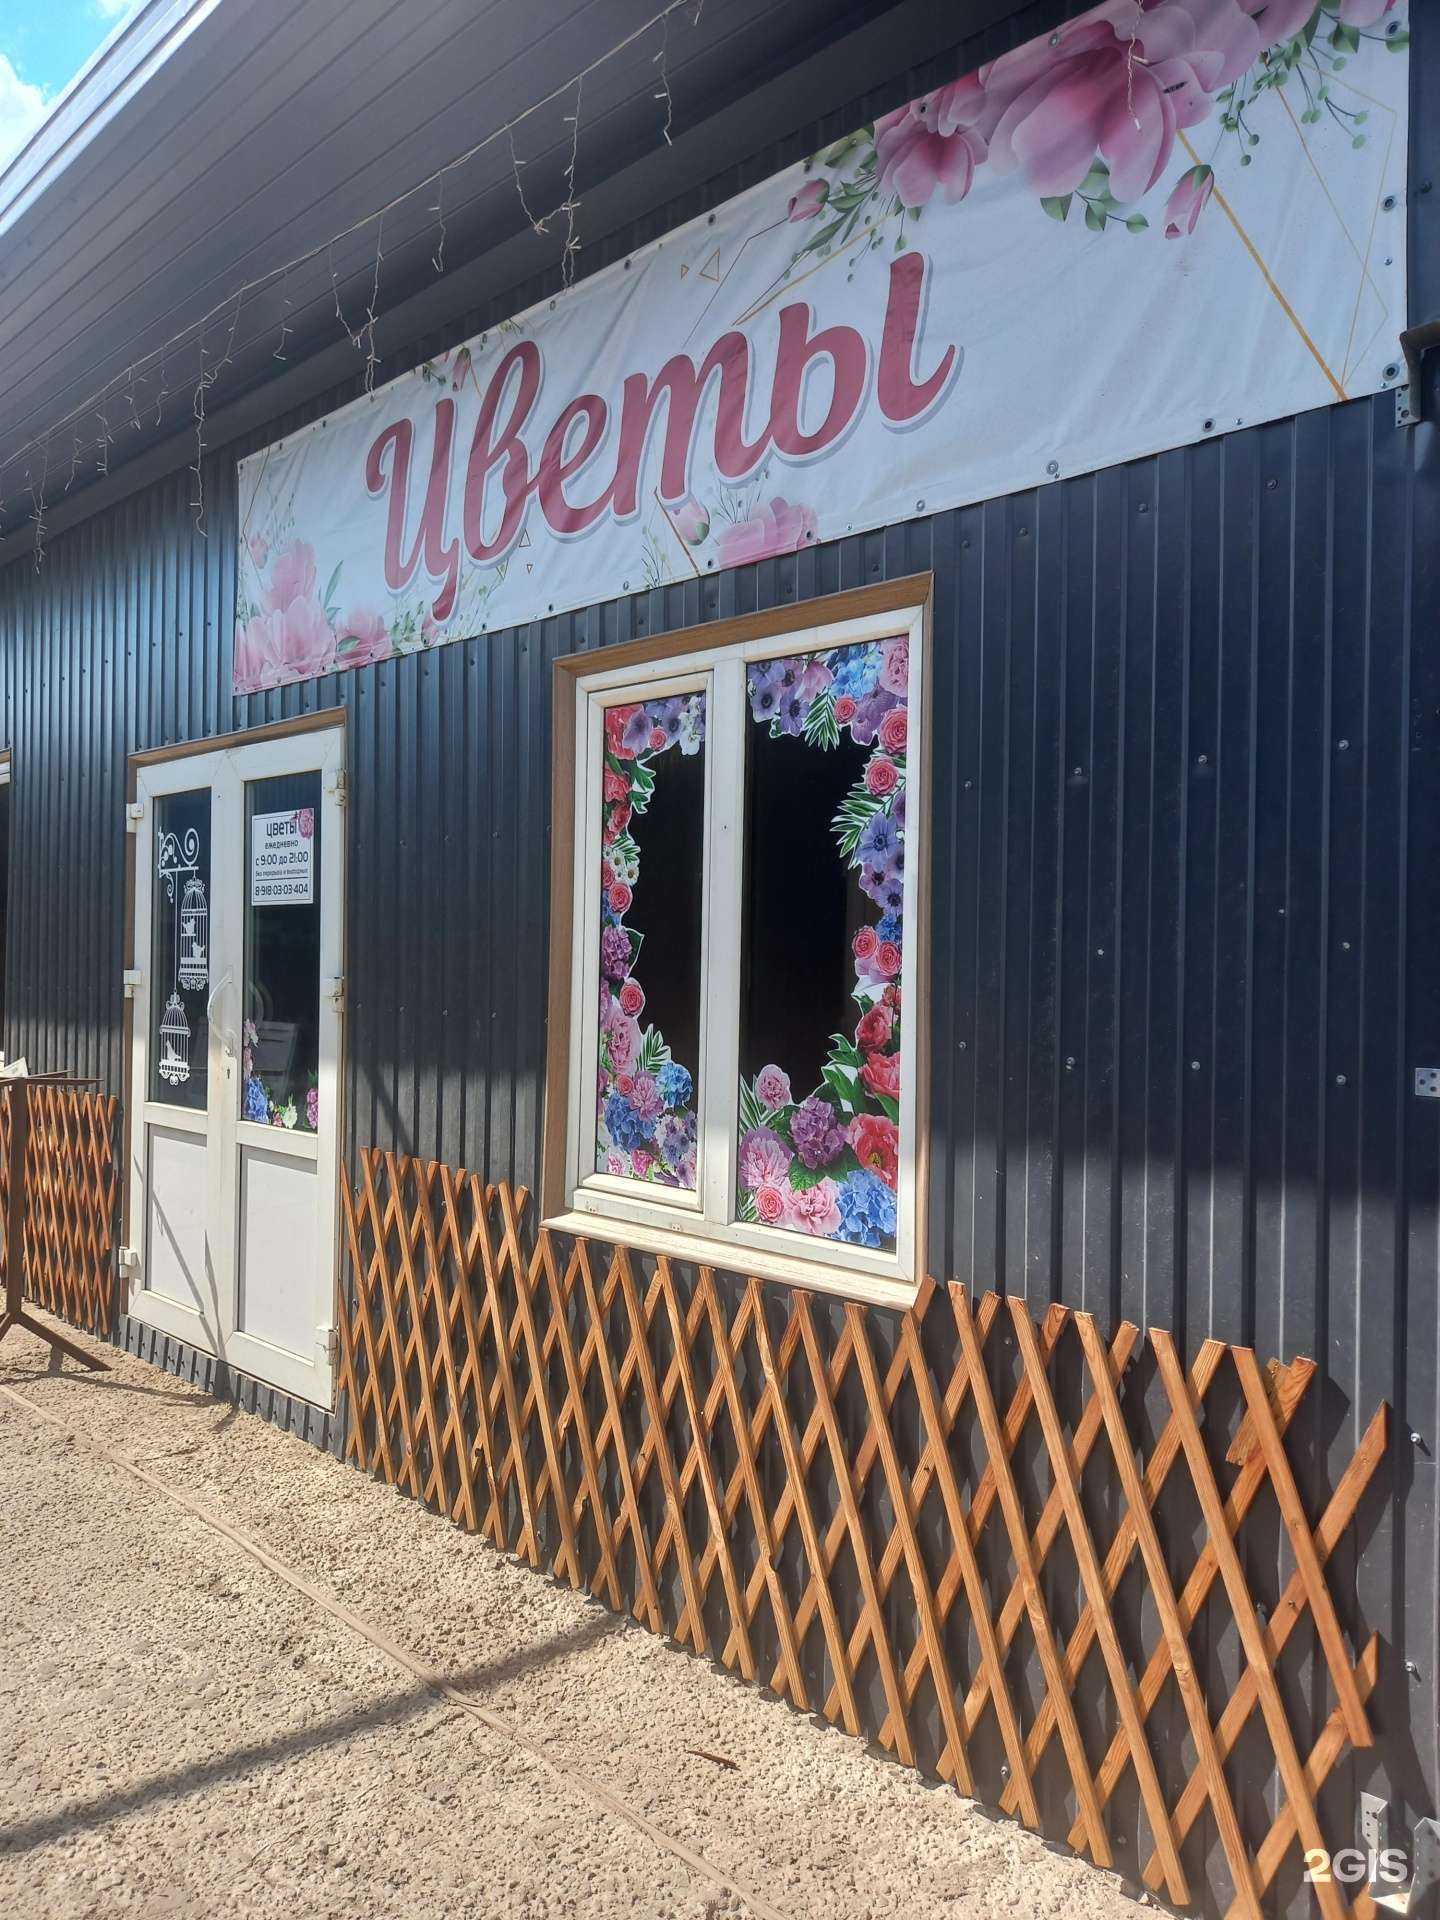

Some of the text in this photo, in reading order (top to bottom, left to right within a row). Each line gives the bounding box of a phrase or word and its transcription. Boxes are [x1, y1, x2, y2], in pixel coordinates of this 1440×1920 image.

[364, 251, 962, 624] Цветы
[278, 855, 288, 866] до
[289, 851, 308, 863] 21:00
